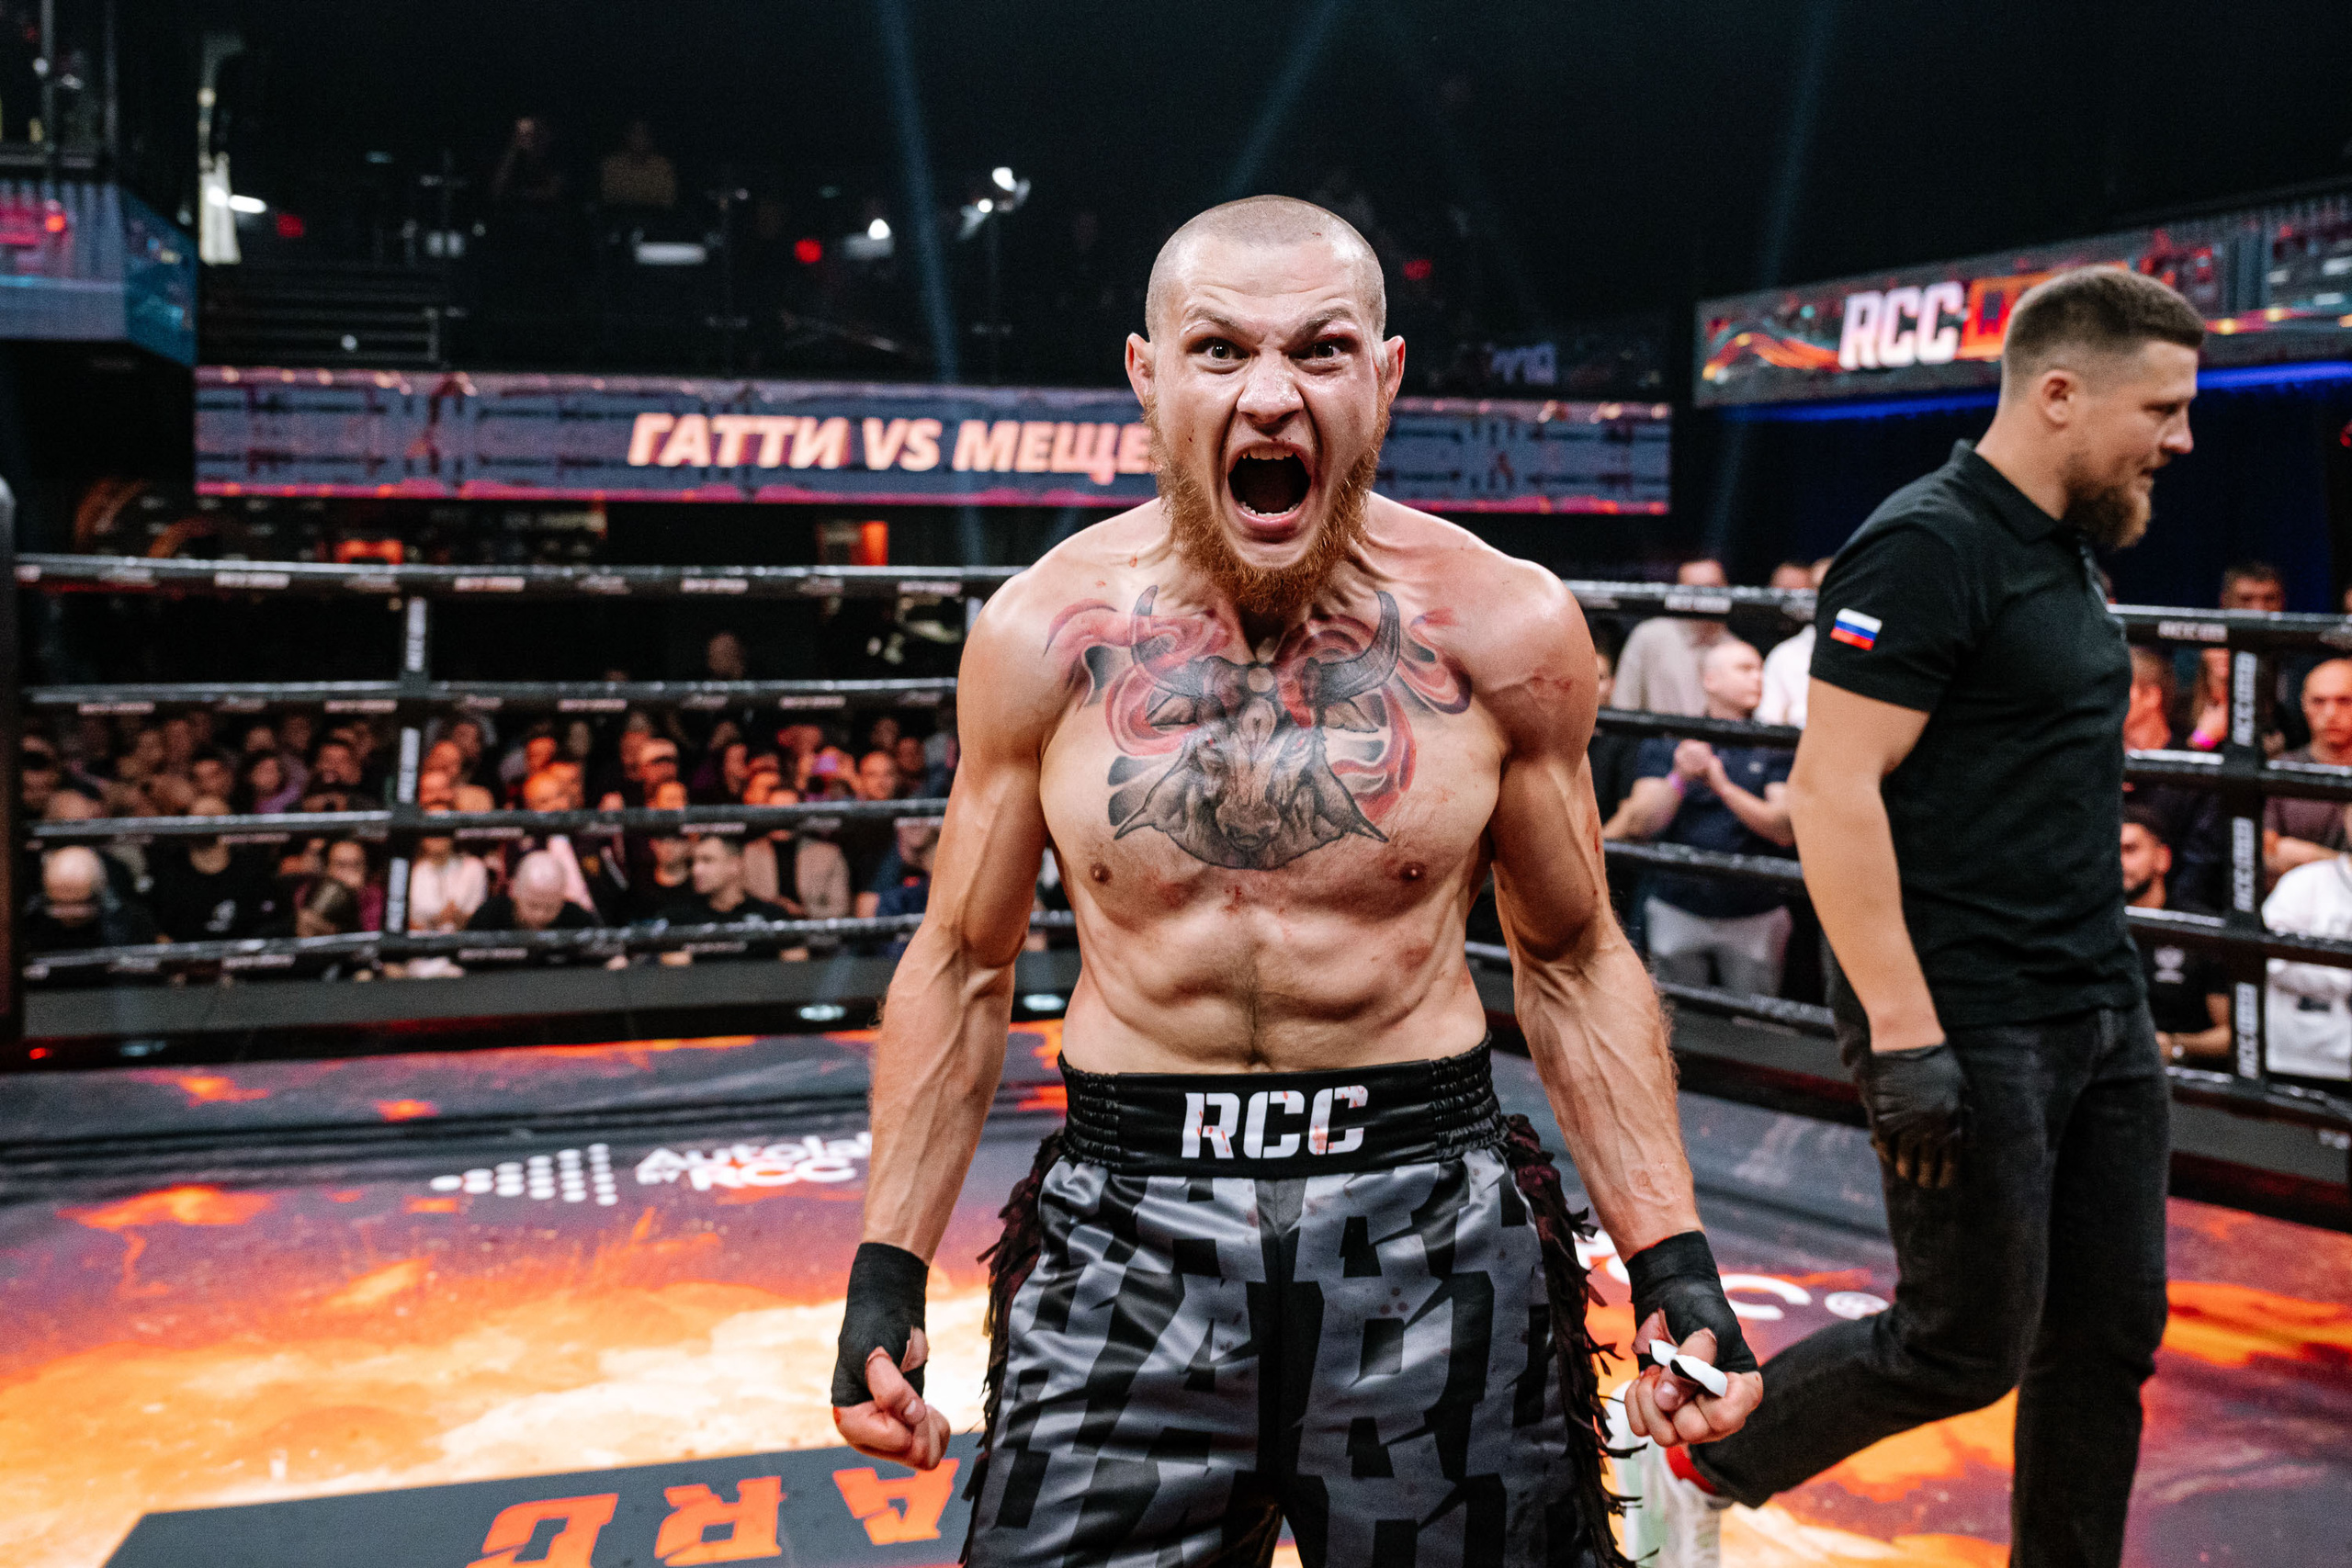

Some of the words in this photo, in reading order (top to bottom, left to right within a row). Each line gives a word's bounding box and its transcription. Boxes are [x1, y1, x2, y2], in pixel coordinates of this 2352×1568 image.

[1838, 281, 1963, 369] RCC
[628, 412, 849, 469] ГАТТИ
[861, 417, 942, 471] VS
[1181, 1085, 1368, 1159] RCC
